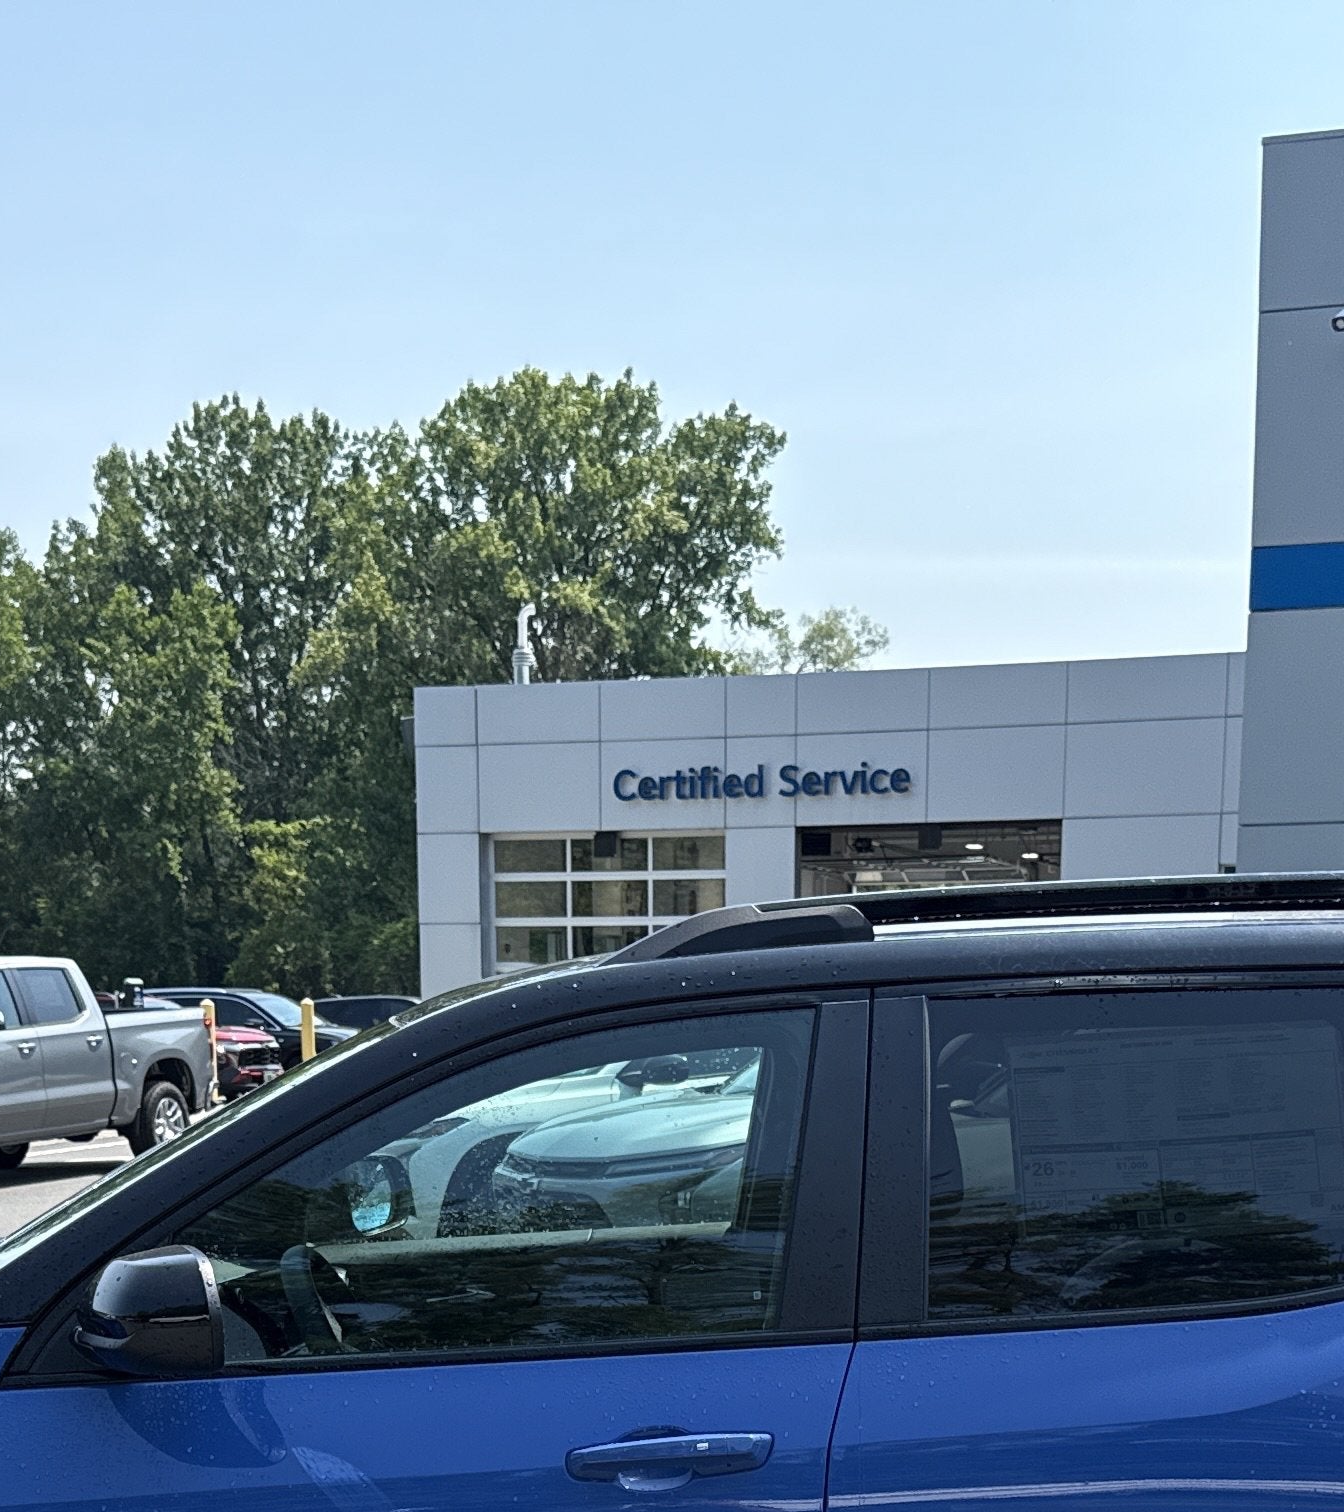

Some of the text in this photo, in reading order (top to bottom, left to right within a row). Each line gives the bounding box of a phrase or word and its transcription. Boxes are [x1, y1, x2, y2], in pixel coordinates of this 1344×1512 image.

[612, 761, 912, 803] Certified Service
[1032, 1161, 1054, 1177] 26
